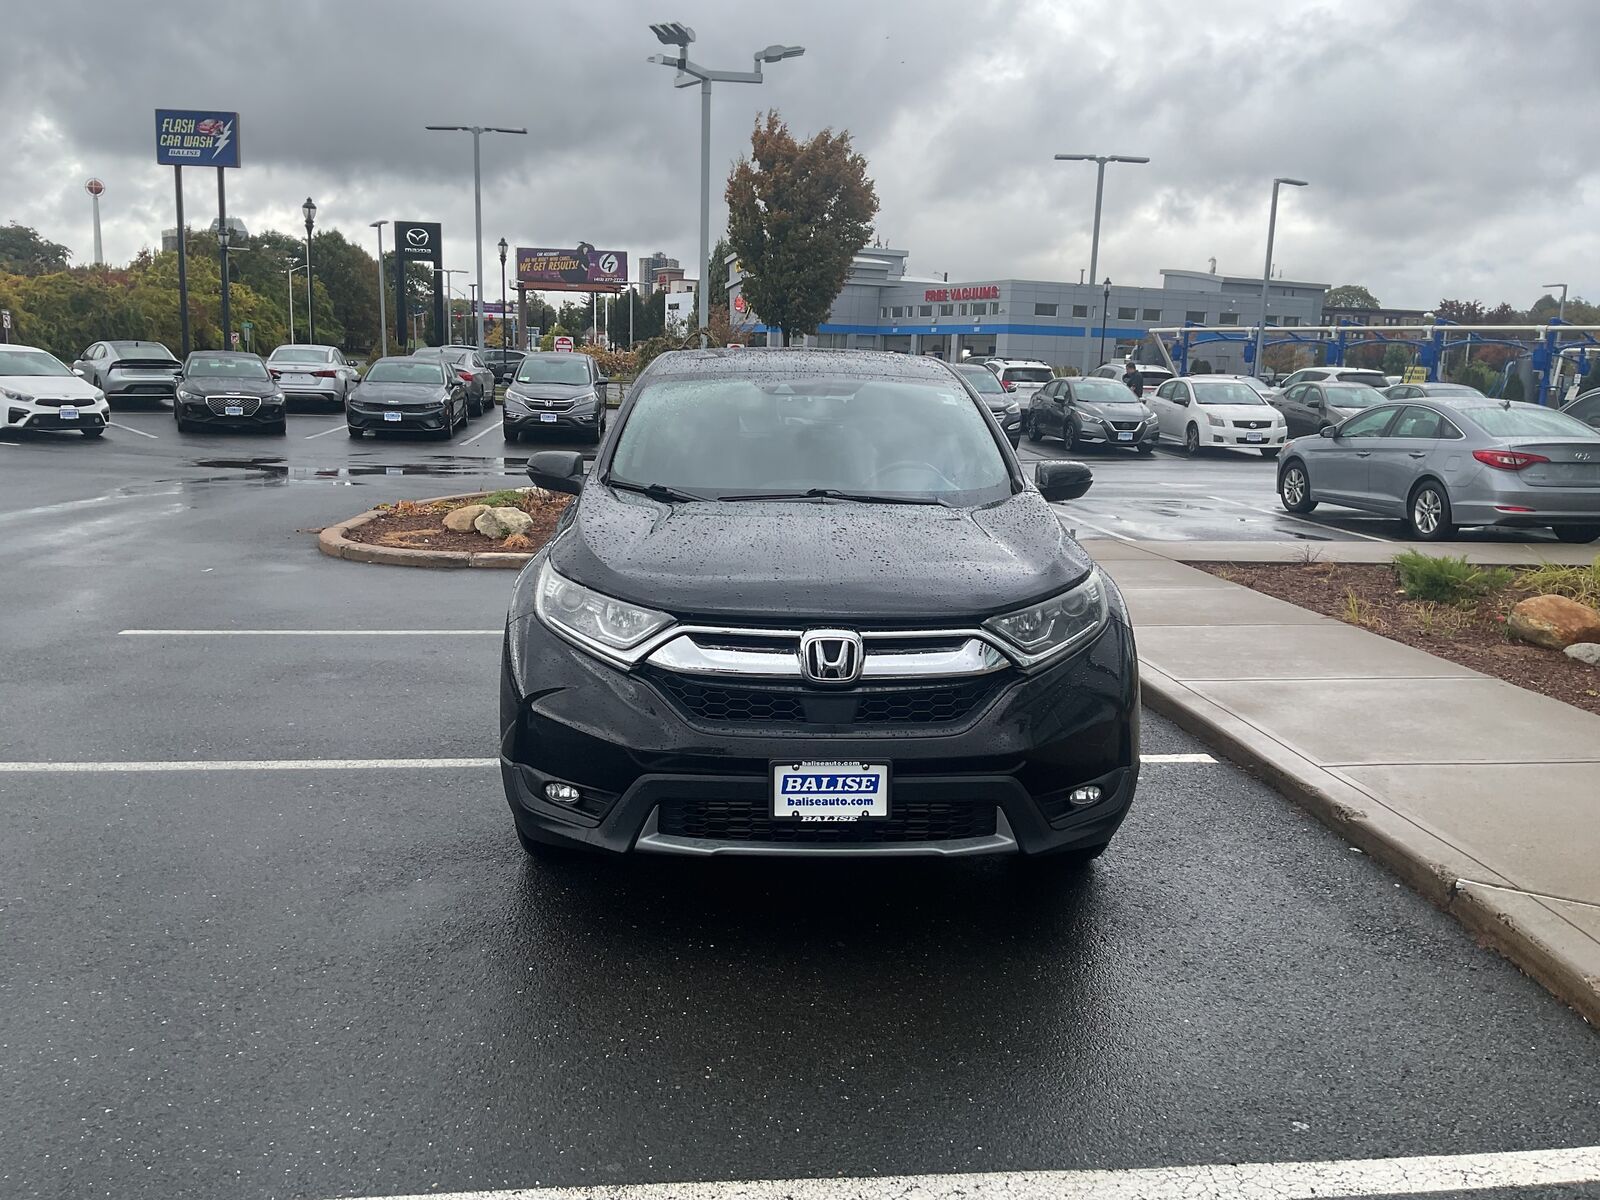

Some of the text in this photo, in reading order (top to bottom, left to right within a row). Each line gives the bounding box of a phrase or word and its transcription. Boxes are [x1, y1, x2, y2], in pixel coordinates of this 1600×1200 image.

[162, 118, 196, 134] FLASH
[160, 134, 214, 148] CAR WASH
[520, 260, 579, 272] WE GET RESULTS!
[925, 285, 1000, 302] FREE VACUUMS
[785, 777, 876, 791] BALISE
[787, 797, 874, 806] baliseauto.com
